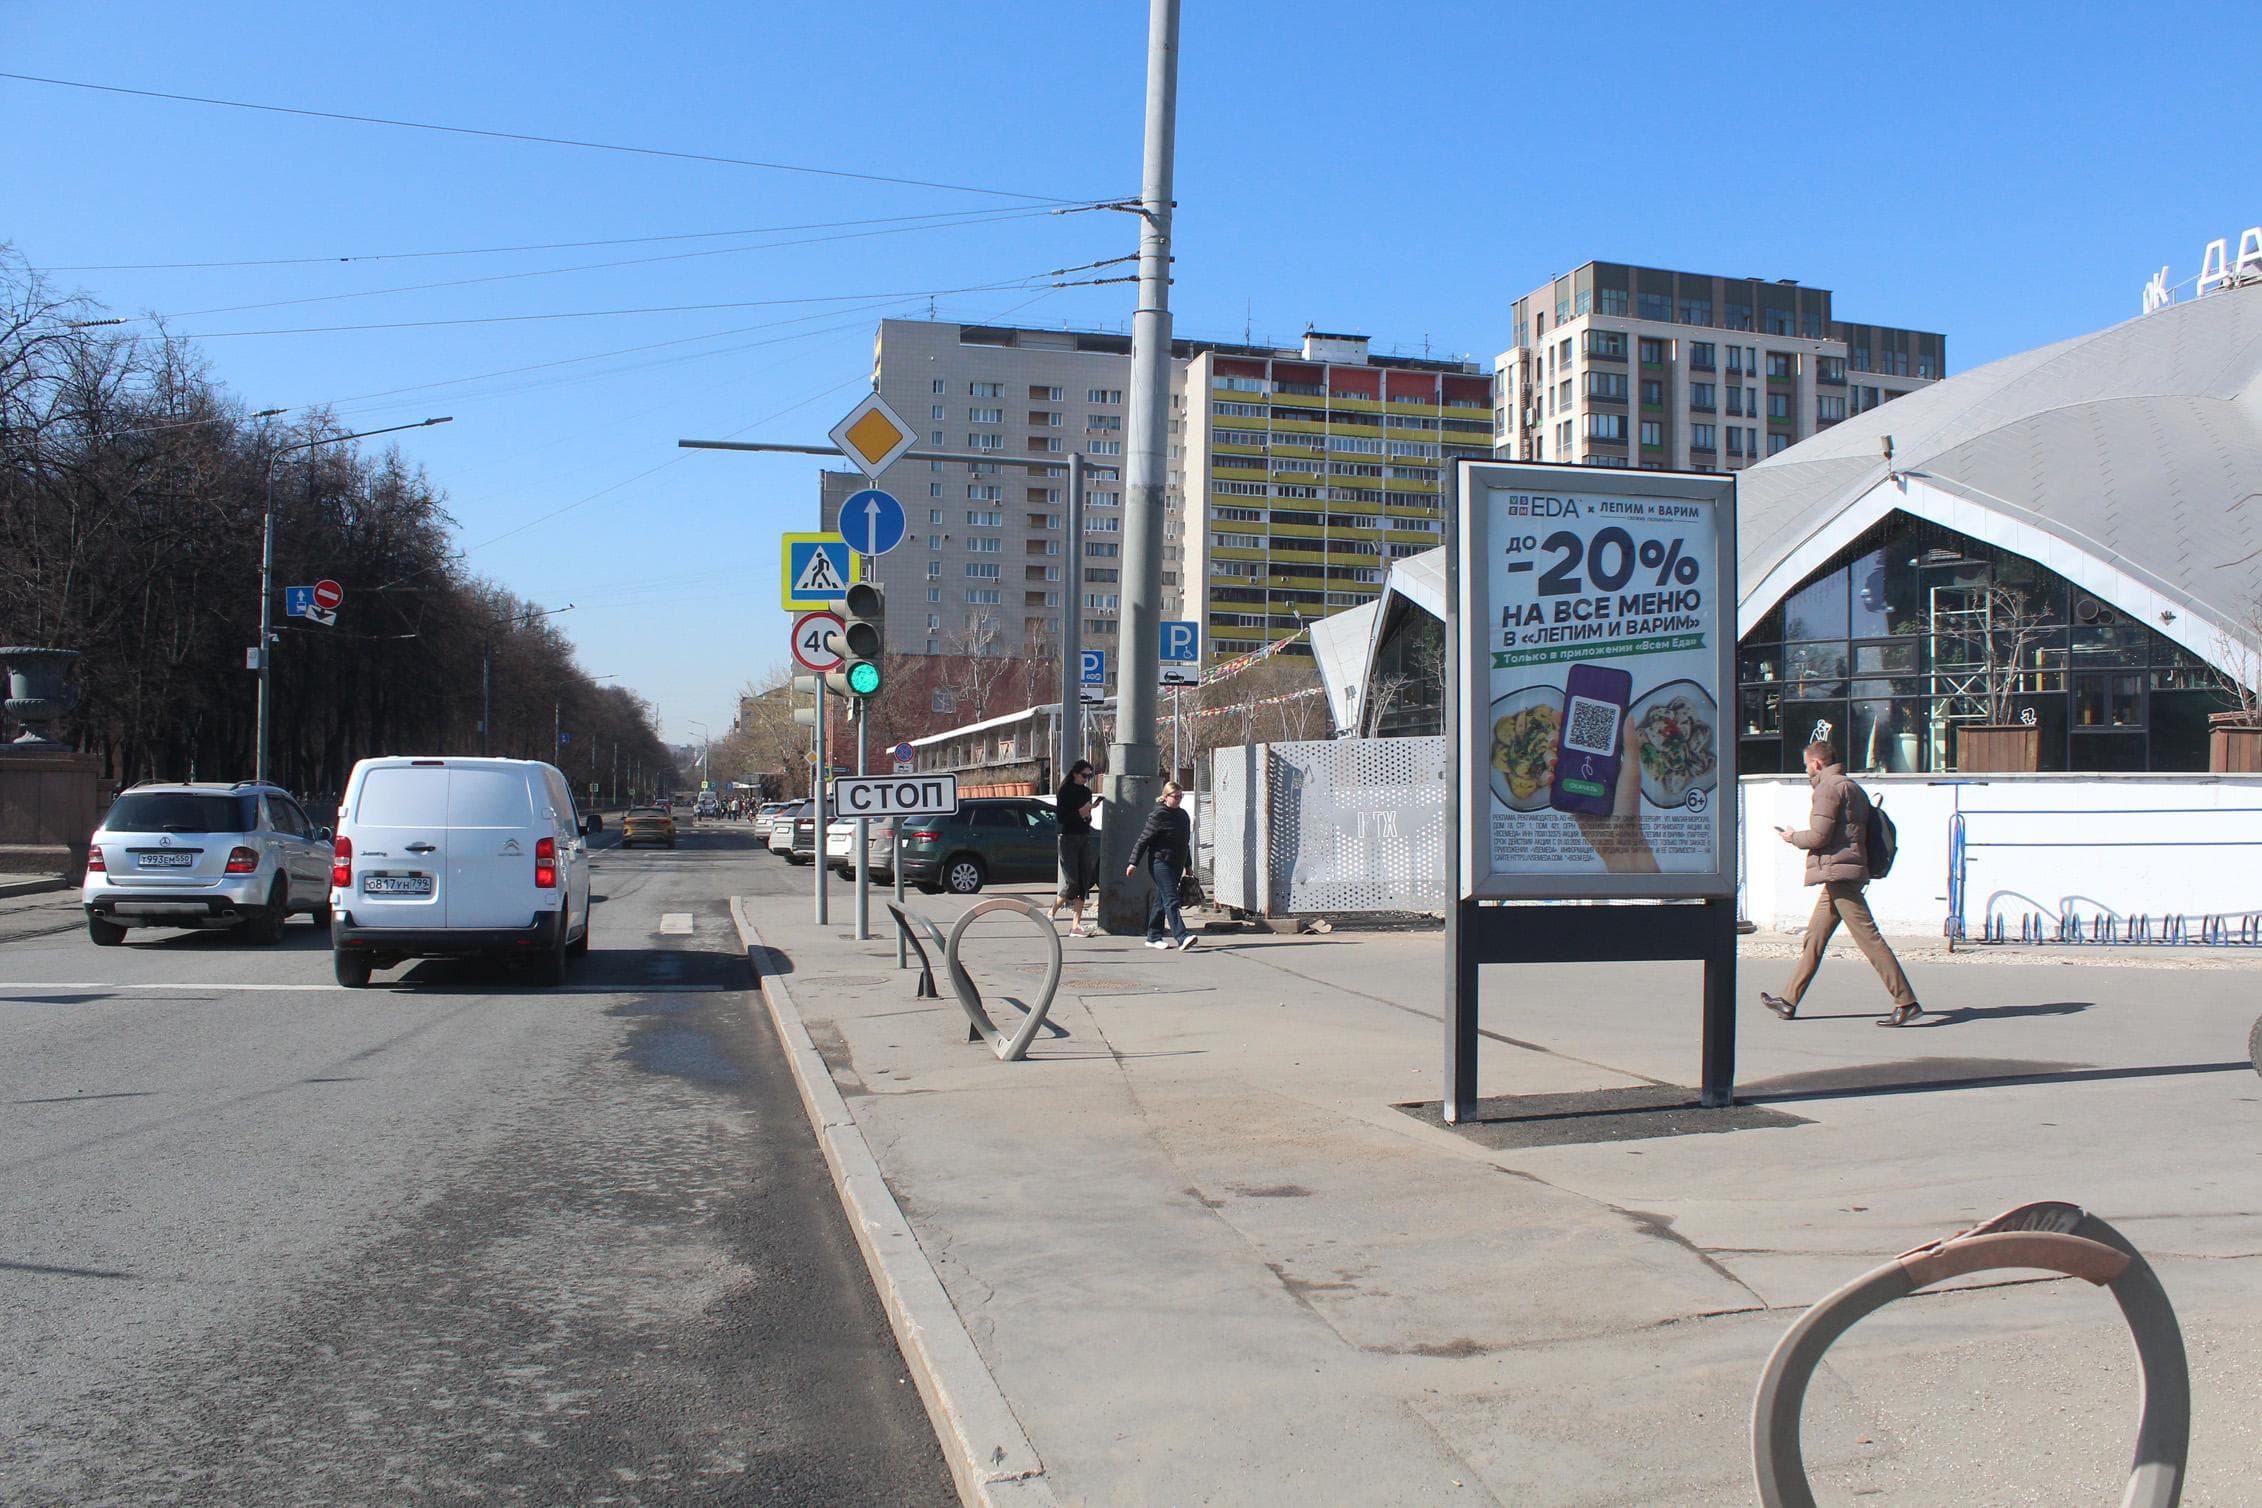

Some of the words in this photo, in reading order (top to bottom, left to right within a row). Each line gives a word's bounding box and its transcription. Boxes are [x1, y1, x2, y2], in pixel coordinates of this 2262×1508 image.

[1600, 501, 1644, 514] ЛЕПИМ
[1658, 505, 1699, 518] ВАРИМ
[1506, 535, 1537, 554] ДО
[1502, 602, 1544, 628] НА
[1554, 596, 1609, 623] ВСЕ
[1619, 589, 1700, 618] МЕНЮ
[1170, 625, 1192, 657] P
[1503, 631, 1516, 647] В
[1521, 624, 1601, 644] «ЛЕПИМ
[1608, 621, 1621, 637] И
[1626, 615, 1699, 635] ВАРИМ»
[1504, 651, 1547, 664] Только
[1560, 644, 1633, 660] приложении
[850, 782, 942, 810] СТОП
[1687, 793, 1705, 808] 6+
